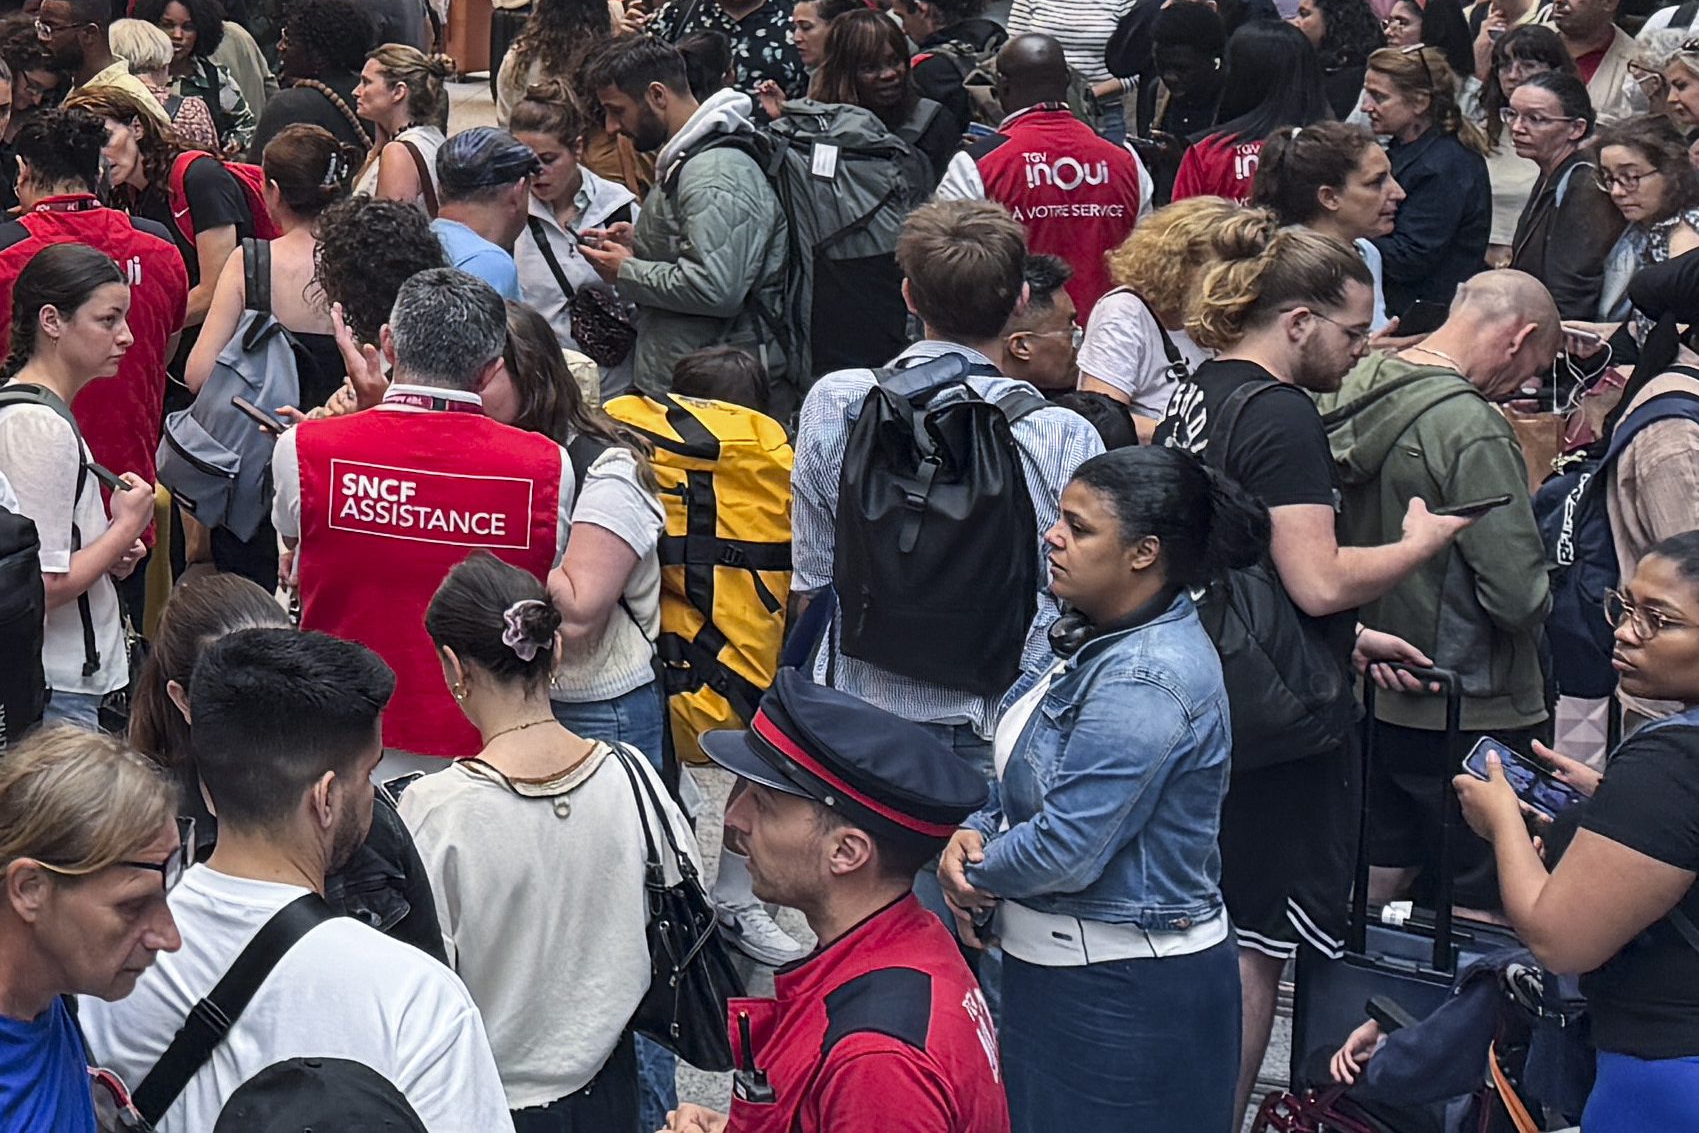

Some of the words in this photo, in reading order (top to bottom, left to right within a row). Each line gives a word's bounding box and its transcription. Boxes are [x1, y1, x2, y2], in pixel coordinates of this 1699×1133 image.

[1022, 151, 1048, 163] TGV
[1027, 205, 1070, 220] VOTRE
[1071, 203, 1124, 218] SERVICE
[341, 472, 417, 503] SNCF
[339, 496, 507, 536] ASSISTANCE
